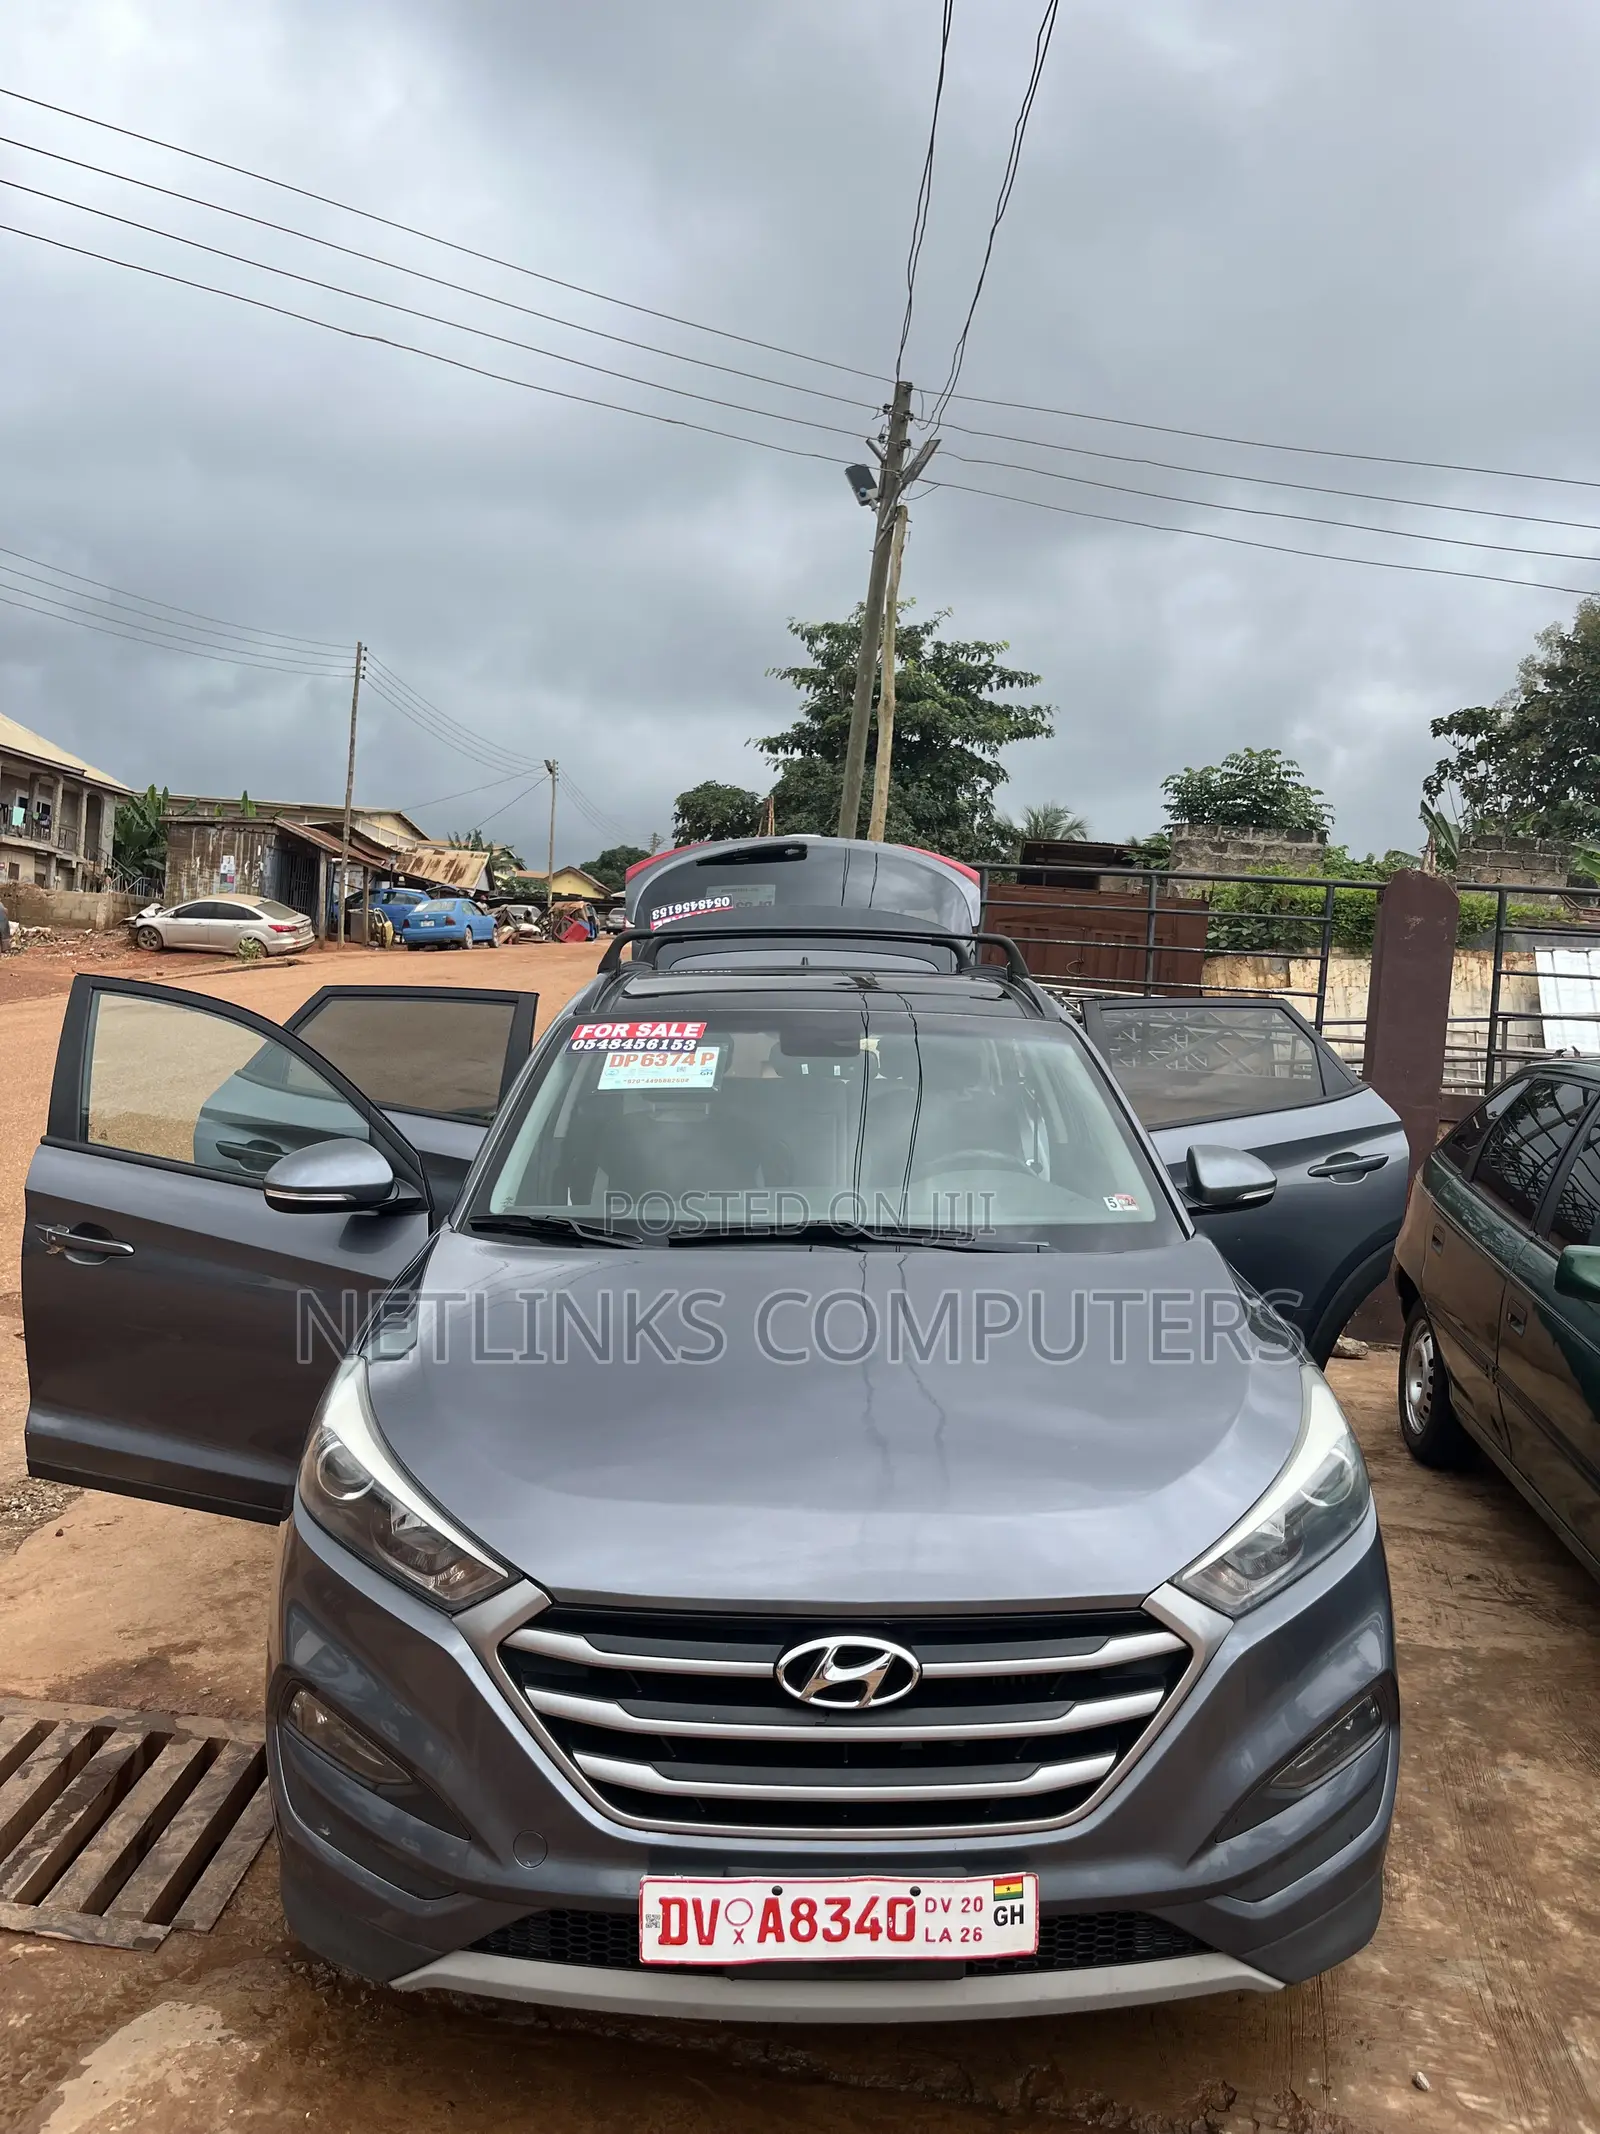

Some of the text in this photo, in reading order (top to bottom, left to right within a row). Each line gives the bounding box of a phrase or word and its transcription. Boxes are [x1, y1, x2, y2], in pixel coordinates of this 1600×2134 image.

[652, 896, 730, 919] 0548456153
[577, 1023, 702, 1038] FOR SALE
[571, 1038, 697, 1051] 0548456153
[609, 1052, 715, 1067] DP 6374 P
[1107, 1198, 1117, 1208] 5
[924, 1895, 984, 1914] DV 20
[658, 1896, 917, 1946] DV A8340
[993, 1904, 1025, 1926] GH
[924, 1926, 983, 1943] LA 26
